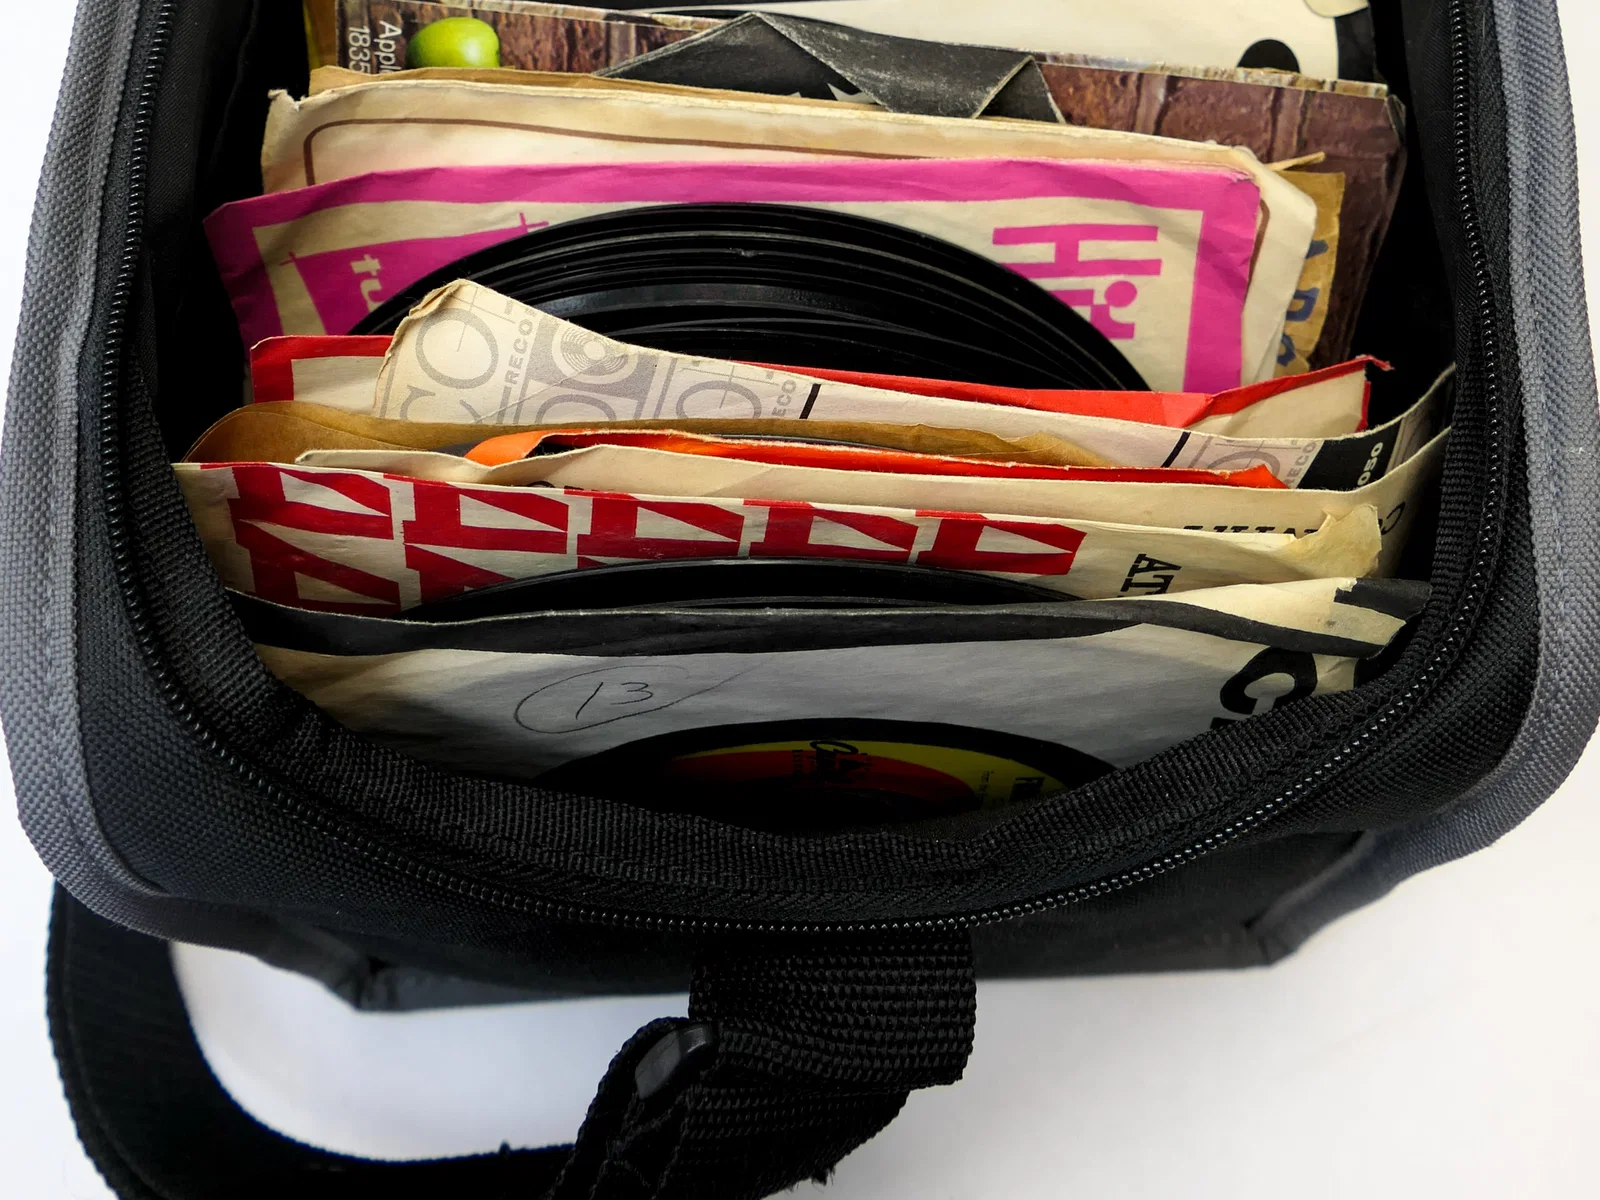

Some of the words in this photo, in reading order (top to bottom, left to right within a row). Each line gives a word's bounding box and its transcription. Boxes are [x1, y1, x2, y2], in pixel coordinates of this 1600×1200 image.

[348, 25, 372, 74] 1835
[1117, 553, 1182, 598] AT
[575, 681, 653, 721] 13
